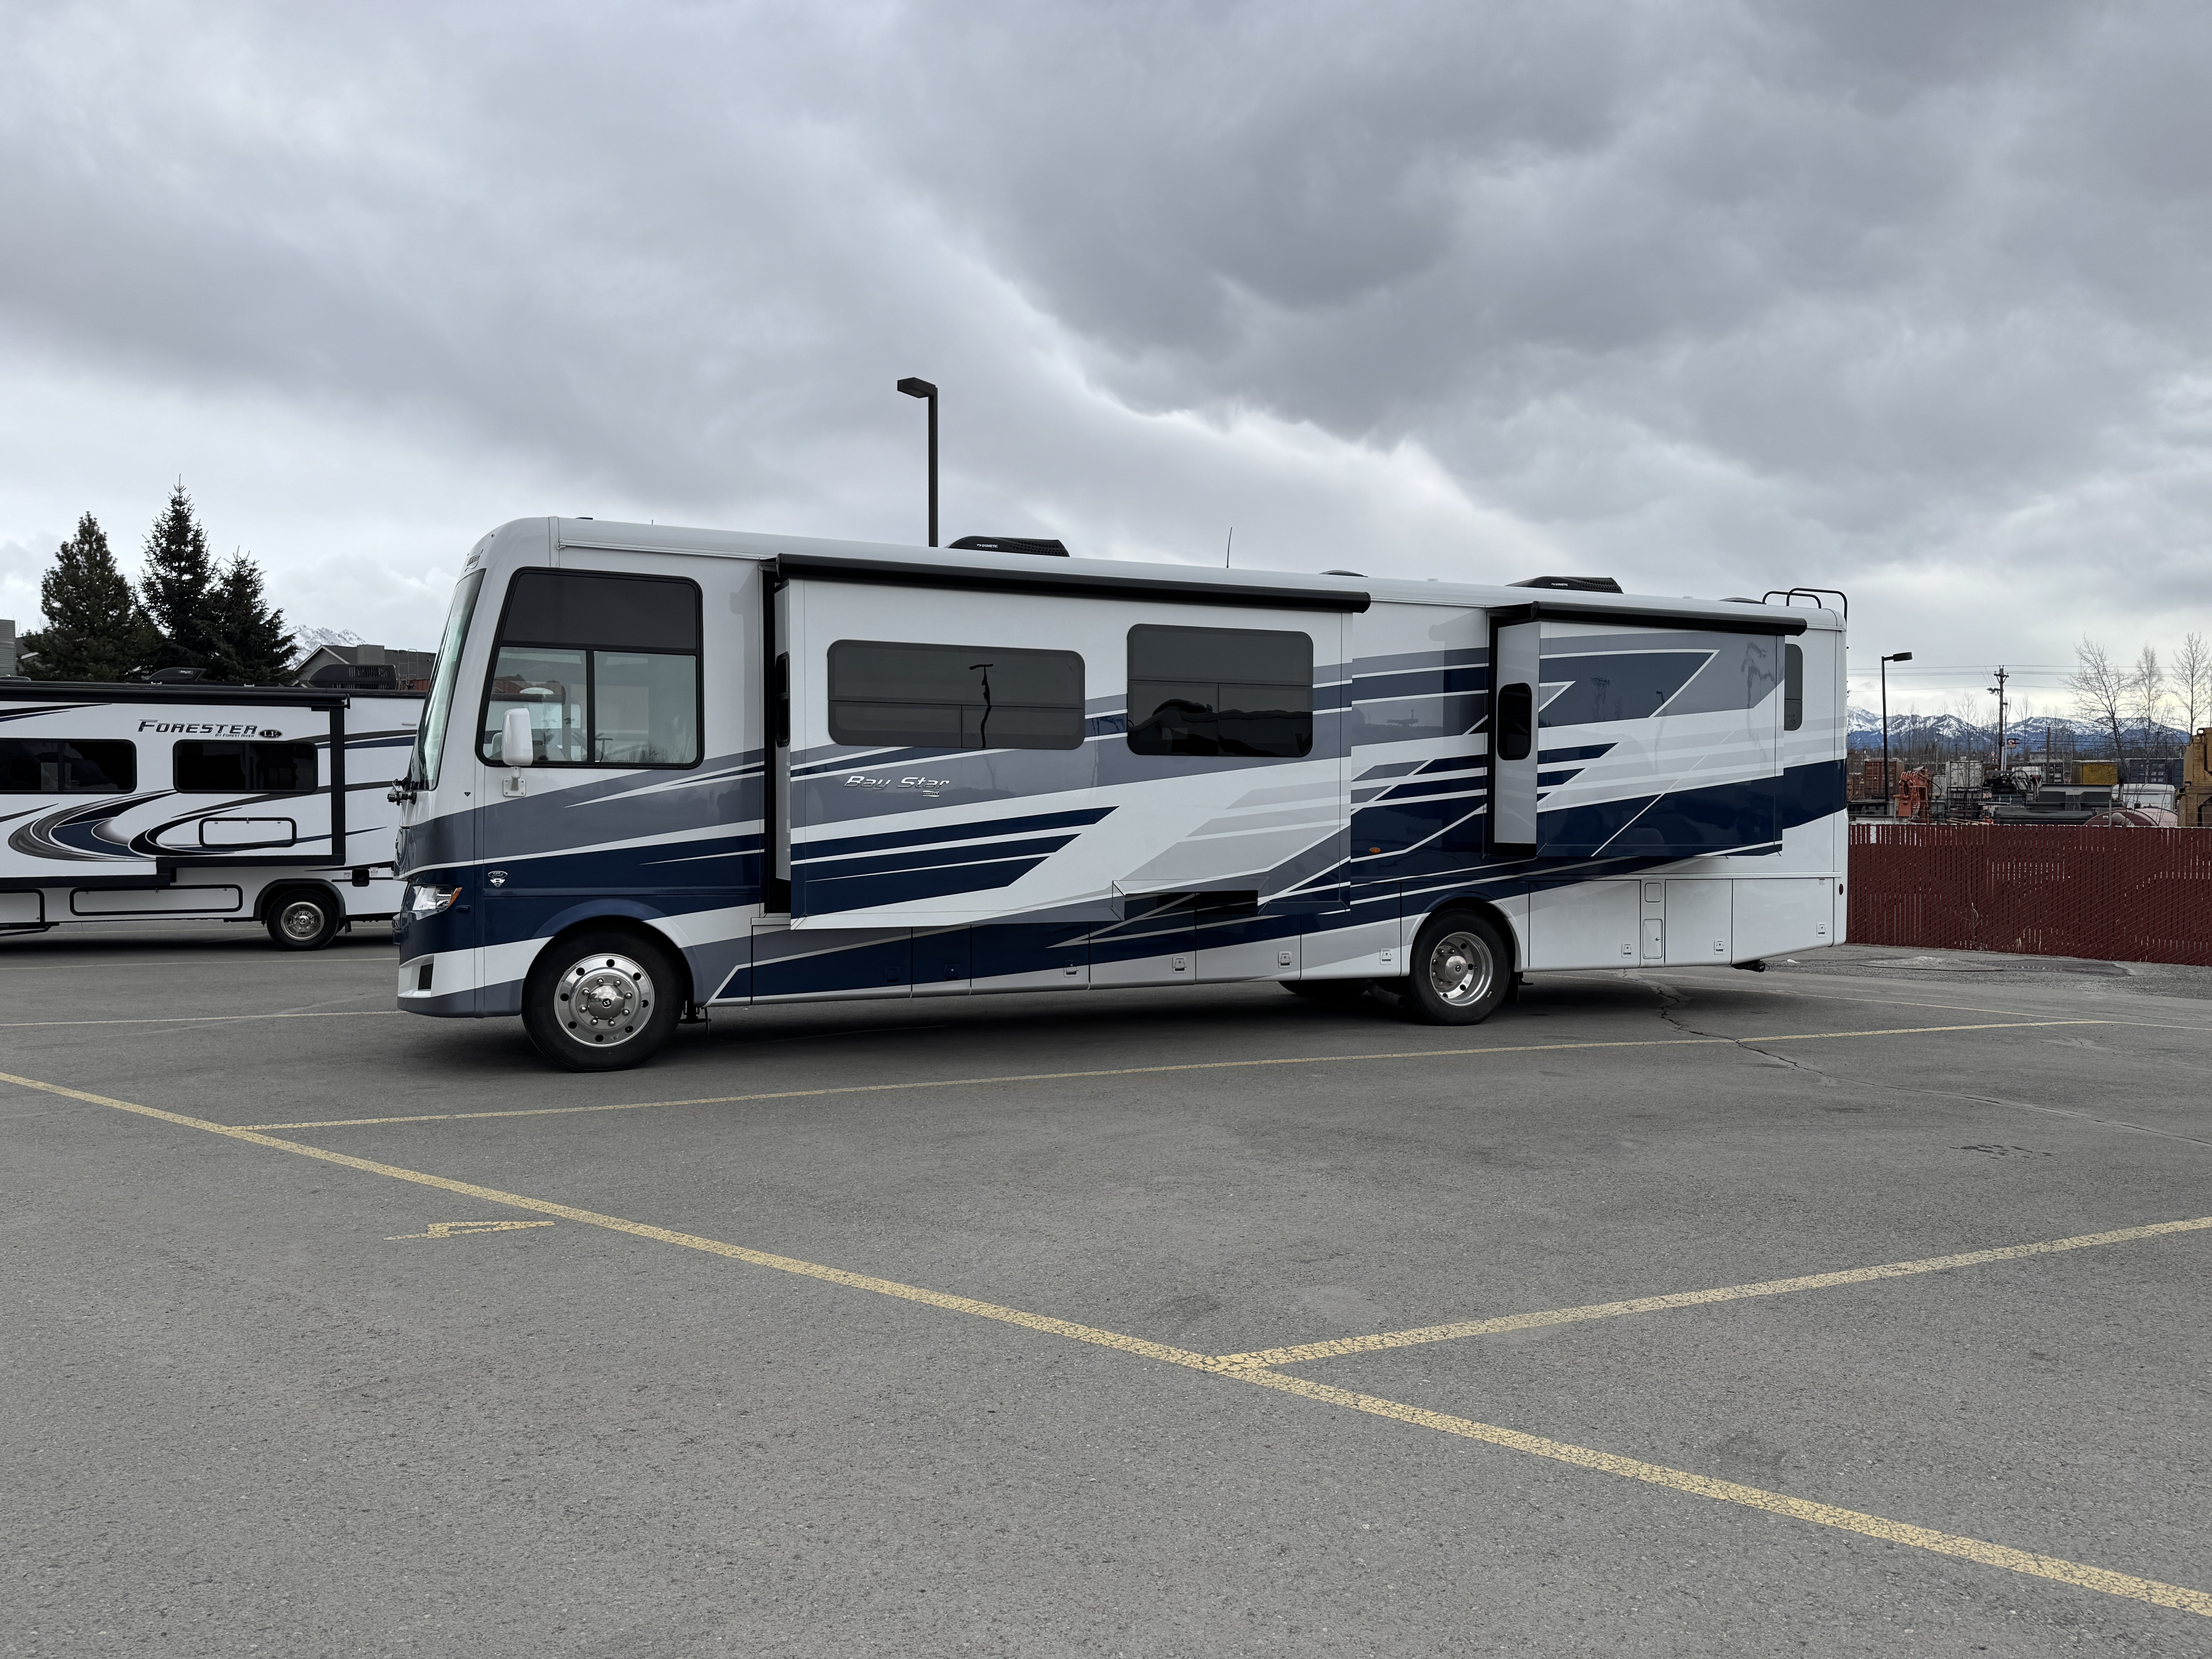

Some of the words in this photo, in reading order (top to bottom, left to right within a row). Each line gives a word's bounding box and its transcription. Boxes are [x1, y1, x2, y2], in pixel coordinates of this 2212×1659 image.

[138, 719, 258, 734] FORESTER
[843, 775, 891, 790] Bay
[897, 777, 950, 788] Star
